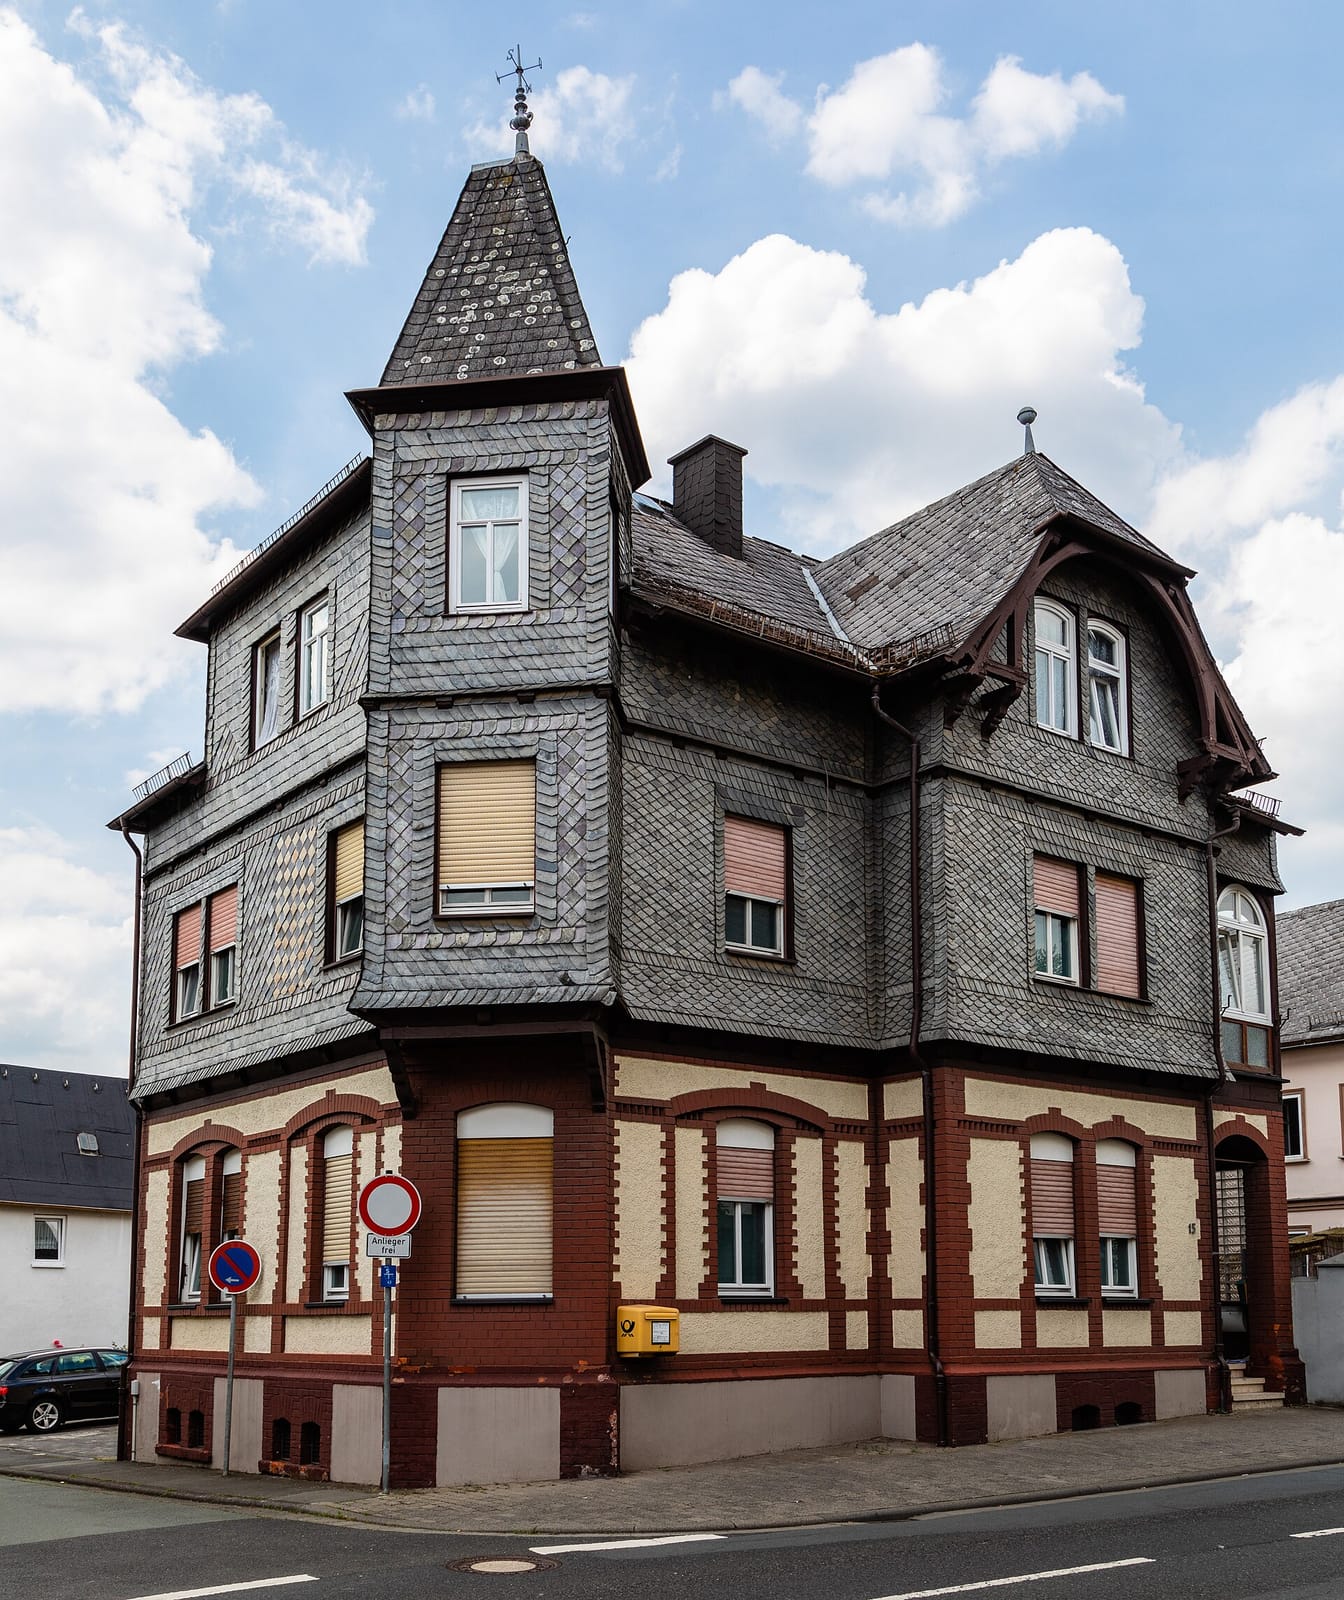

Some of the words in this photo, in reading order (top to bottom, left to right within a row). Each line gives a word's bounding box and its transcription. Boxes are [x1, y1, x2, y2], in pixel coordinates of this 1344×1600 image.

[1188, 1222, 1196, 1235] 15
[371, 1236, 406, 1247] Anlieger
[381, 1246, 396, 1254] frei
